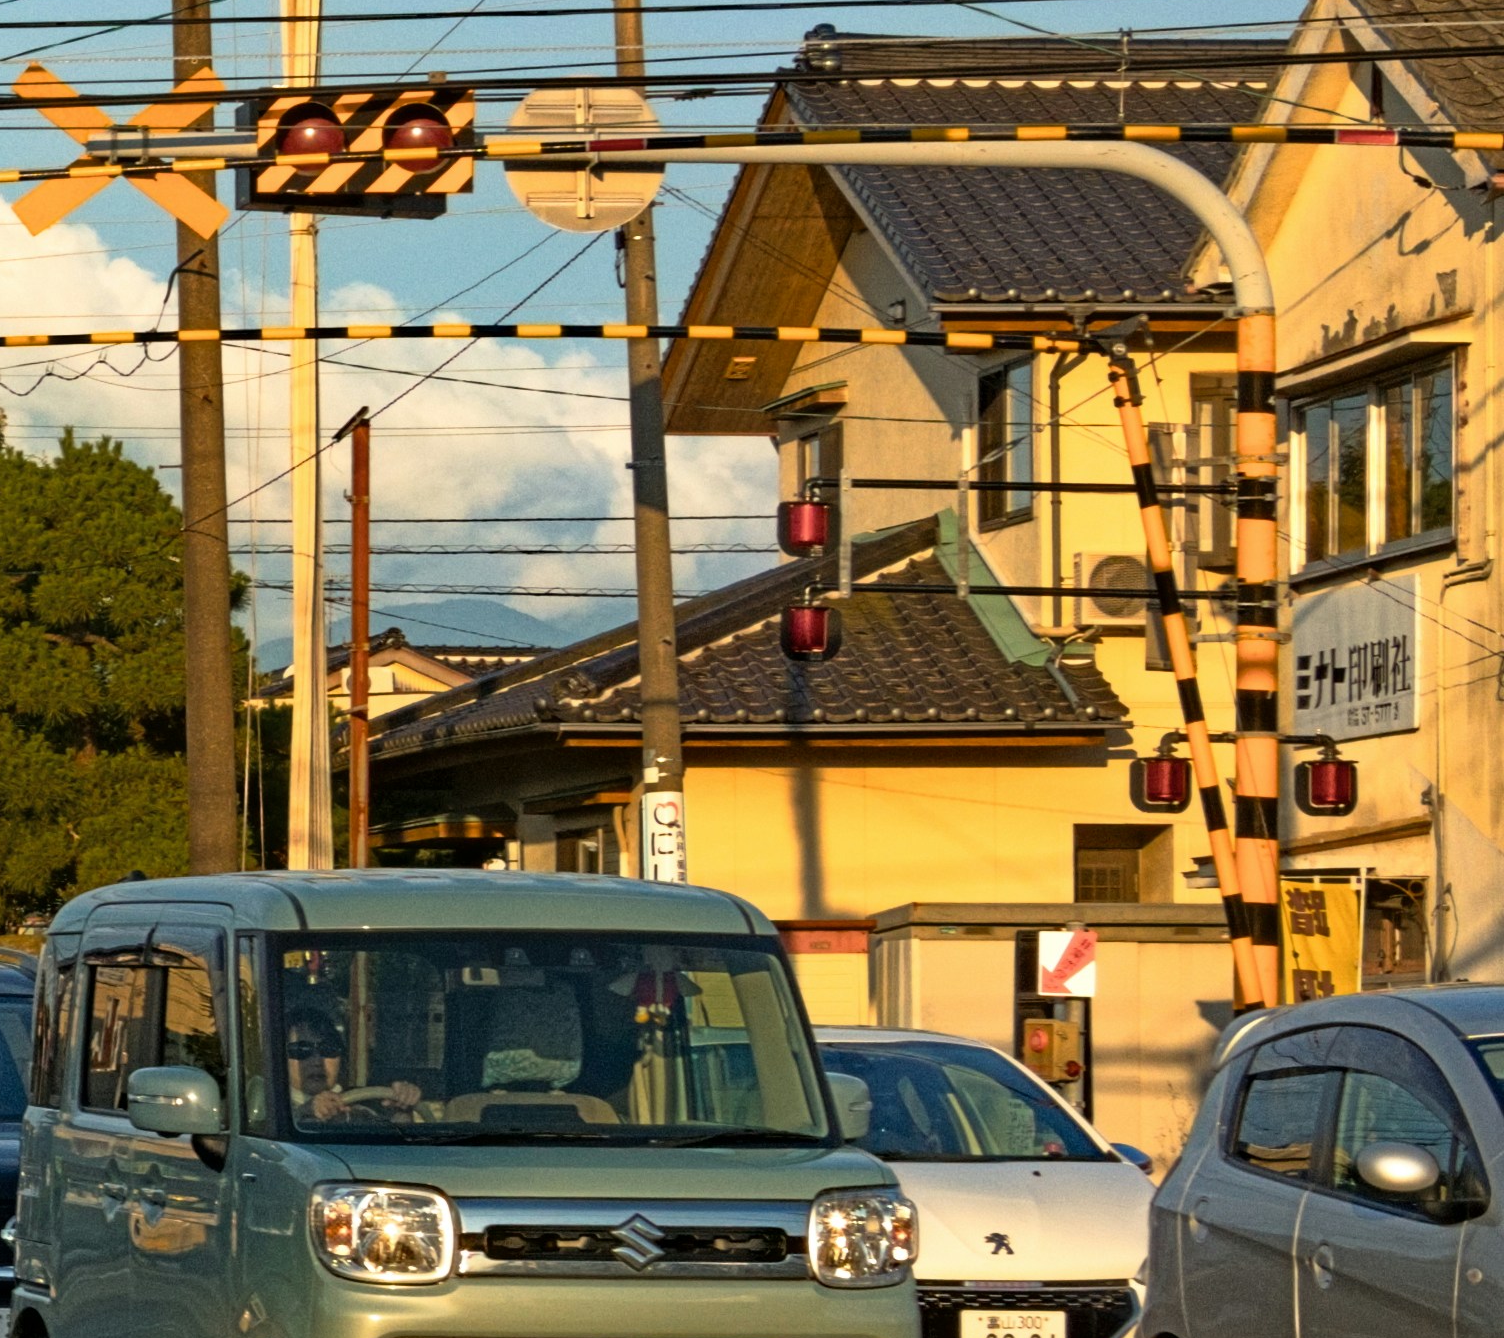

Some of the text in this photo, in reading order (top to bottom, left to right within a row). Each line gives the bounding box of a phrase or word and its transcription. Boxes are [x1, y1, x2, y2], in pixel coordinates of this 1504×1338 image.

[1296, 635, 1411, 710] ミナト印刷社
[986, 1315, 1043, 1330] 富山300
